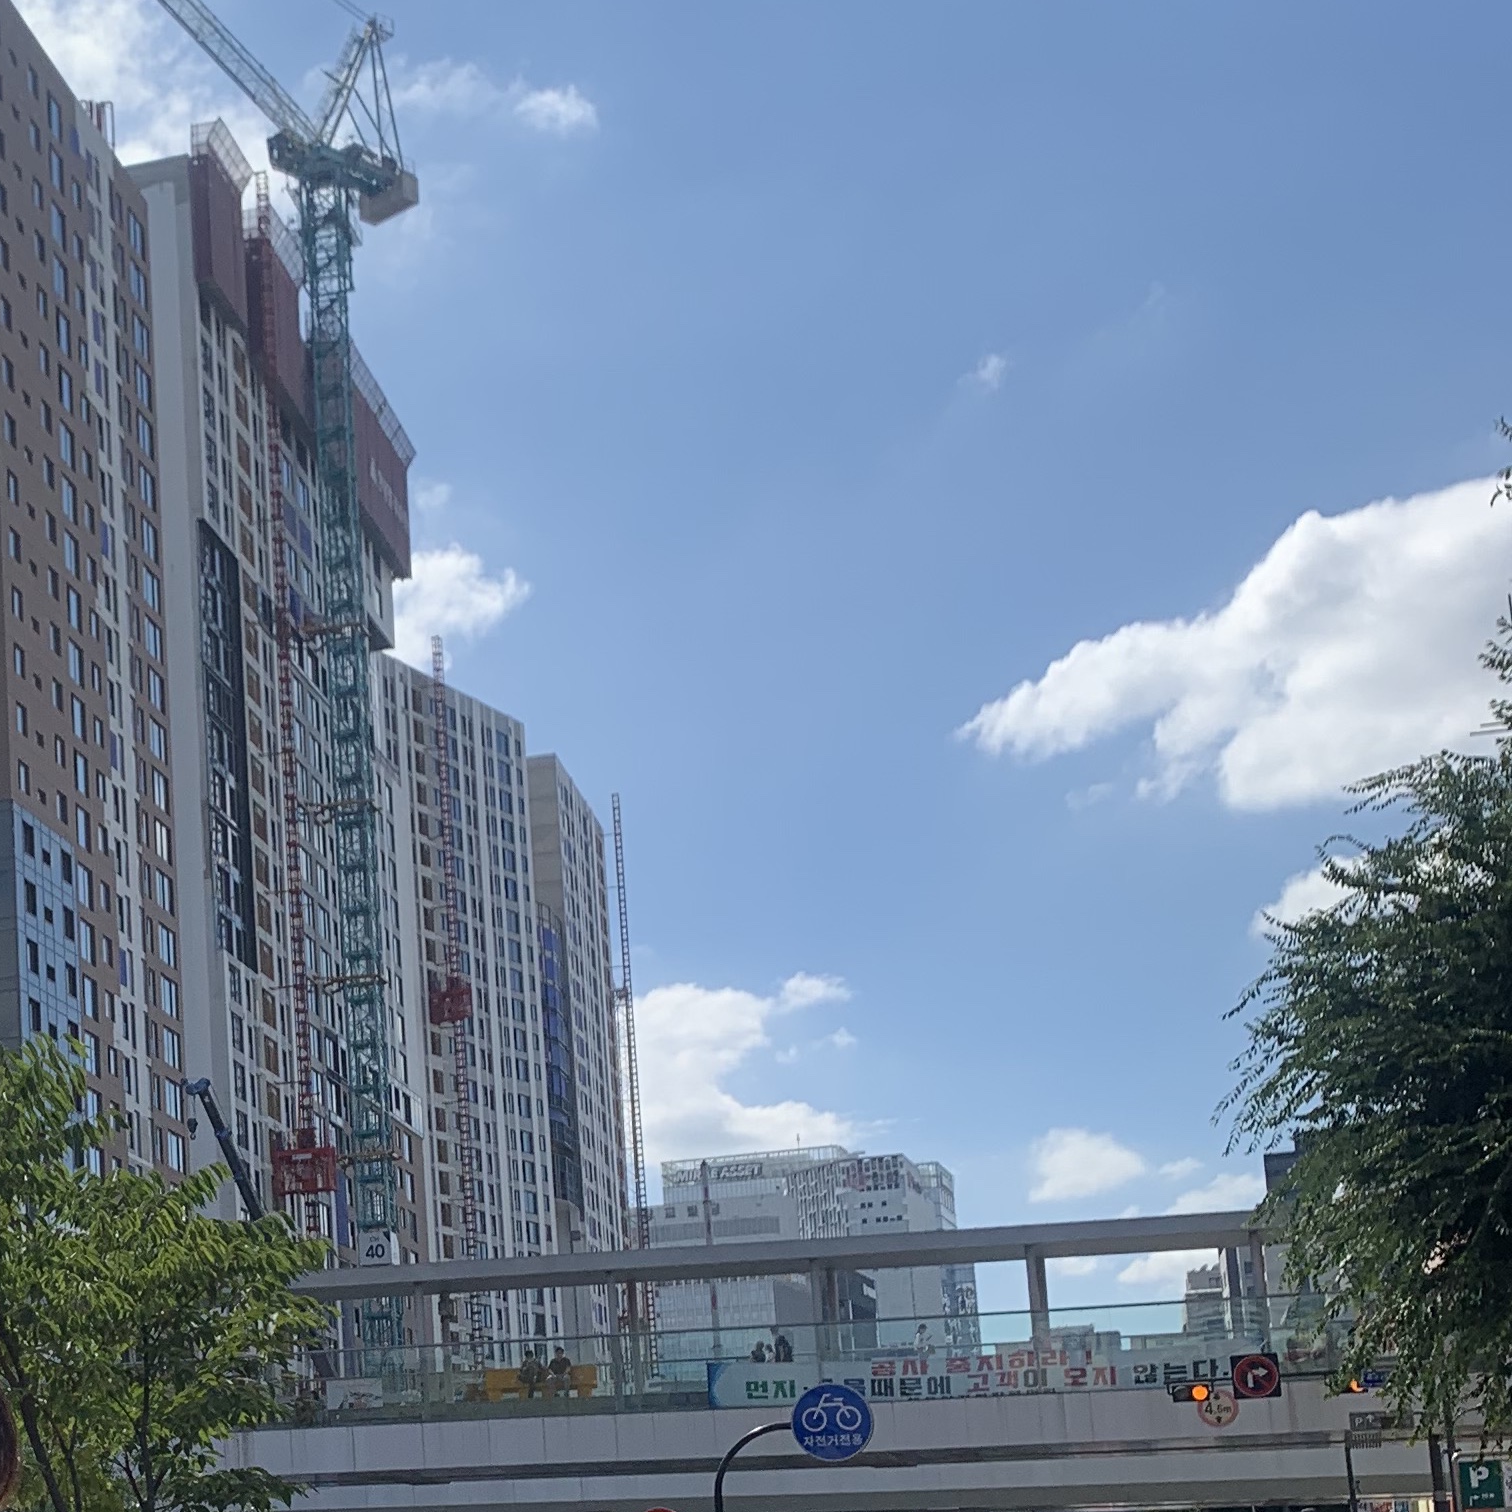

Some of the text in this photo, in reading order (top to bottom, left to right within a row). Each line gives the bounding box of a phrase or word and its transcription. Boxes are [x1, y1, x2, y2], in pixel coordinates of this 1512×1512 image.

[720, 1163, 763, 1179] ASSET
[366, 1243, 385, 1258] 40
[871, 1357, 930, 1377] 공사
[745, 1379, 796, 1399] 먼지
[1064, 1366, 1117, 1387] 오지
[803, 1433, 864, 1448] 자전거전용
[1469, 1465, 1489, 1489] P
